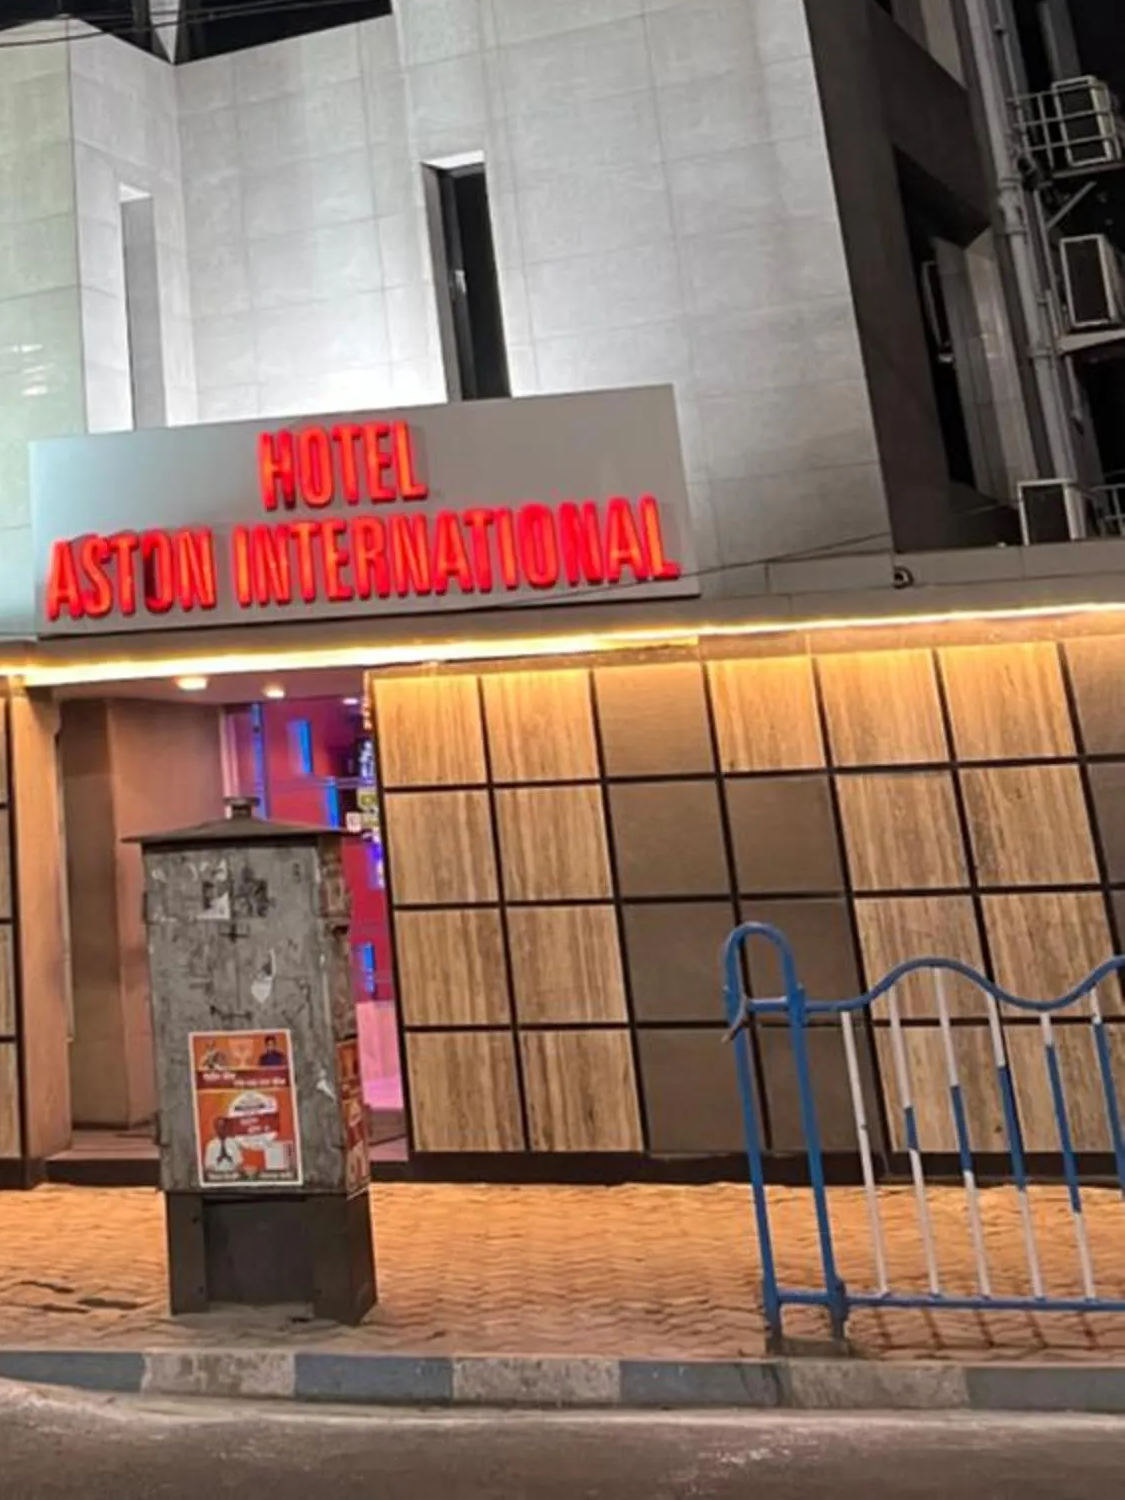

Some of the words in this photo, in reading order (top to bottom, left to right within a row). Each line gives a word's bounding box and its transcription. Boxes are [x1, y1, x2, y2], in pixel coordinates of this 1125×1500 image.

[256, 420, 429, 510] HOTEL
[45, 526, 219, 621] ASTON
[231, 492, 682, 609] INTERNATIONAL
